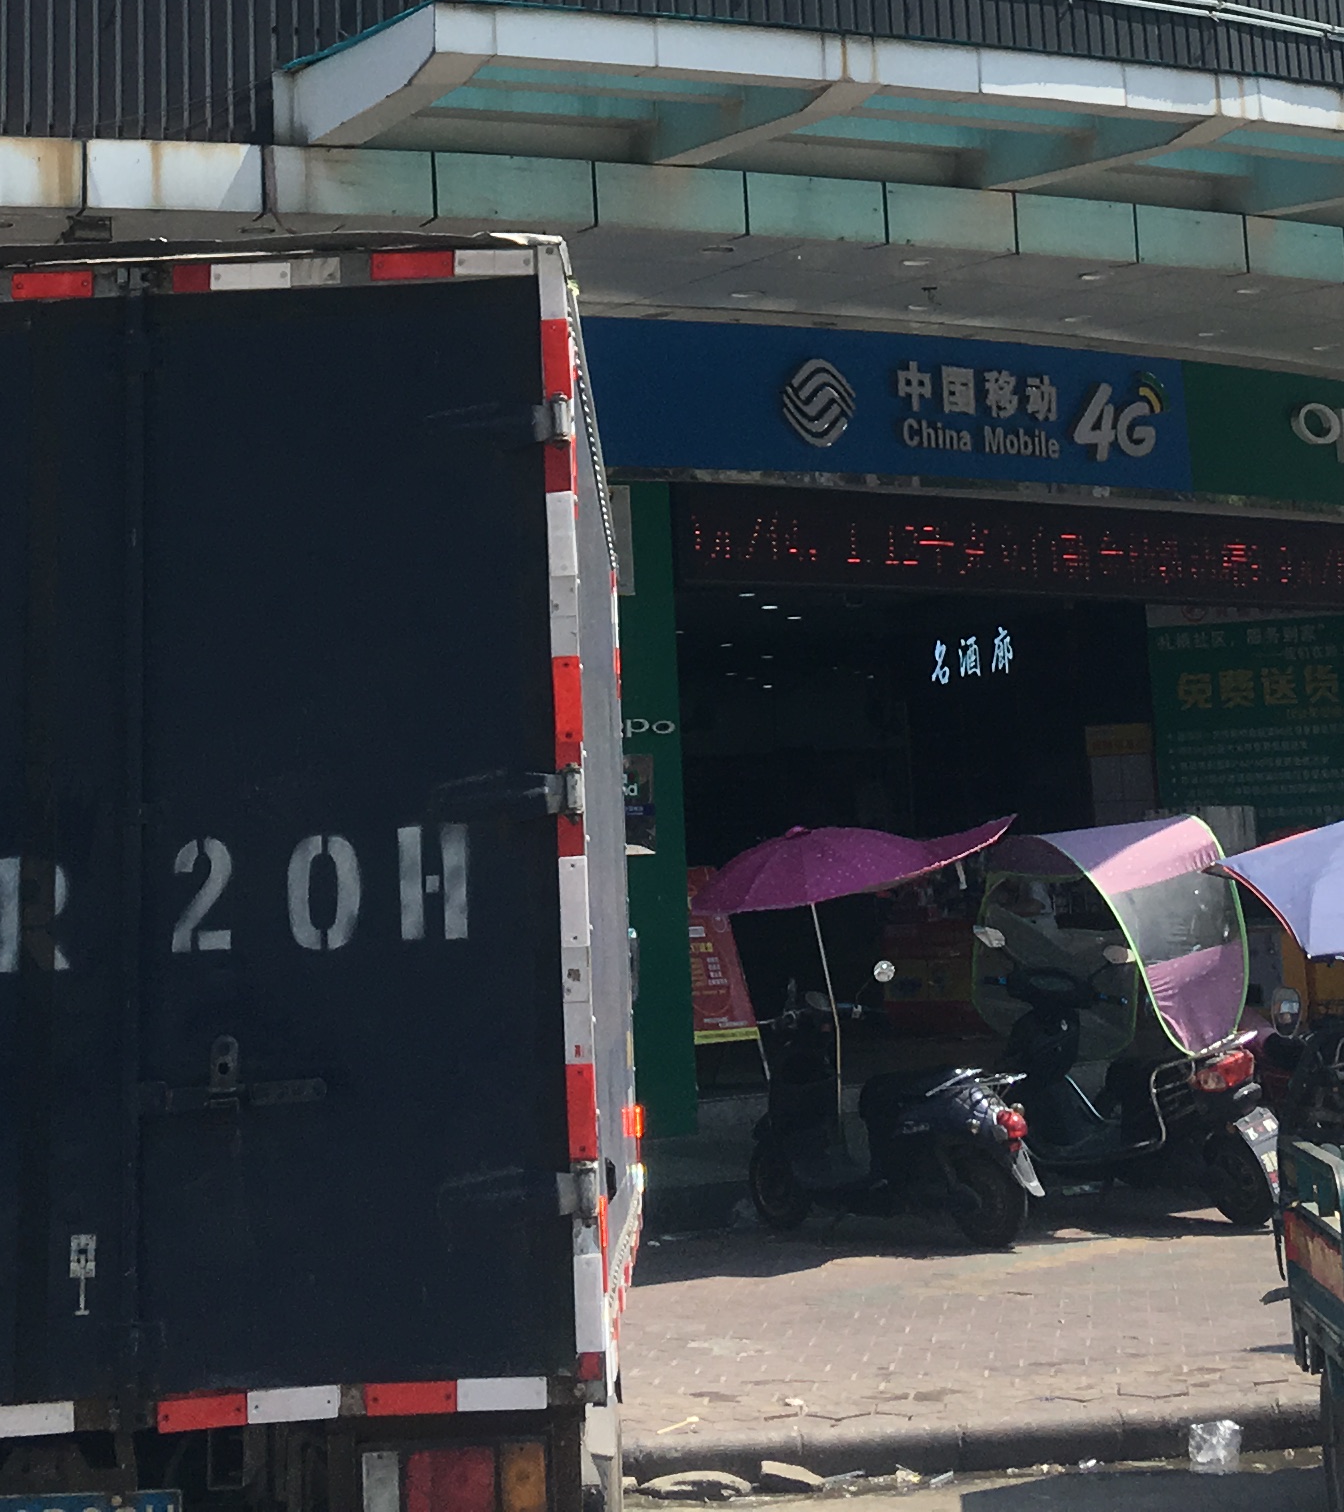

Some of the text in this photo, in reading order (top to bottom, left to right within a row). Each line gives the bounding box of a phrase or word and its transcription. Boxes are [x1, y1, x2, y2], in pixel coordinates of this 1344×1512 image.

[896, 360, 1059, 422] 中国移动
[902, 418, 1060, 459] China Mobile
[1073, 382, 1157, 463] 4G
[929, 625, 1016, 686] 名酒廊
[1179, 666, 1340, 709] 免费送货
